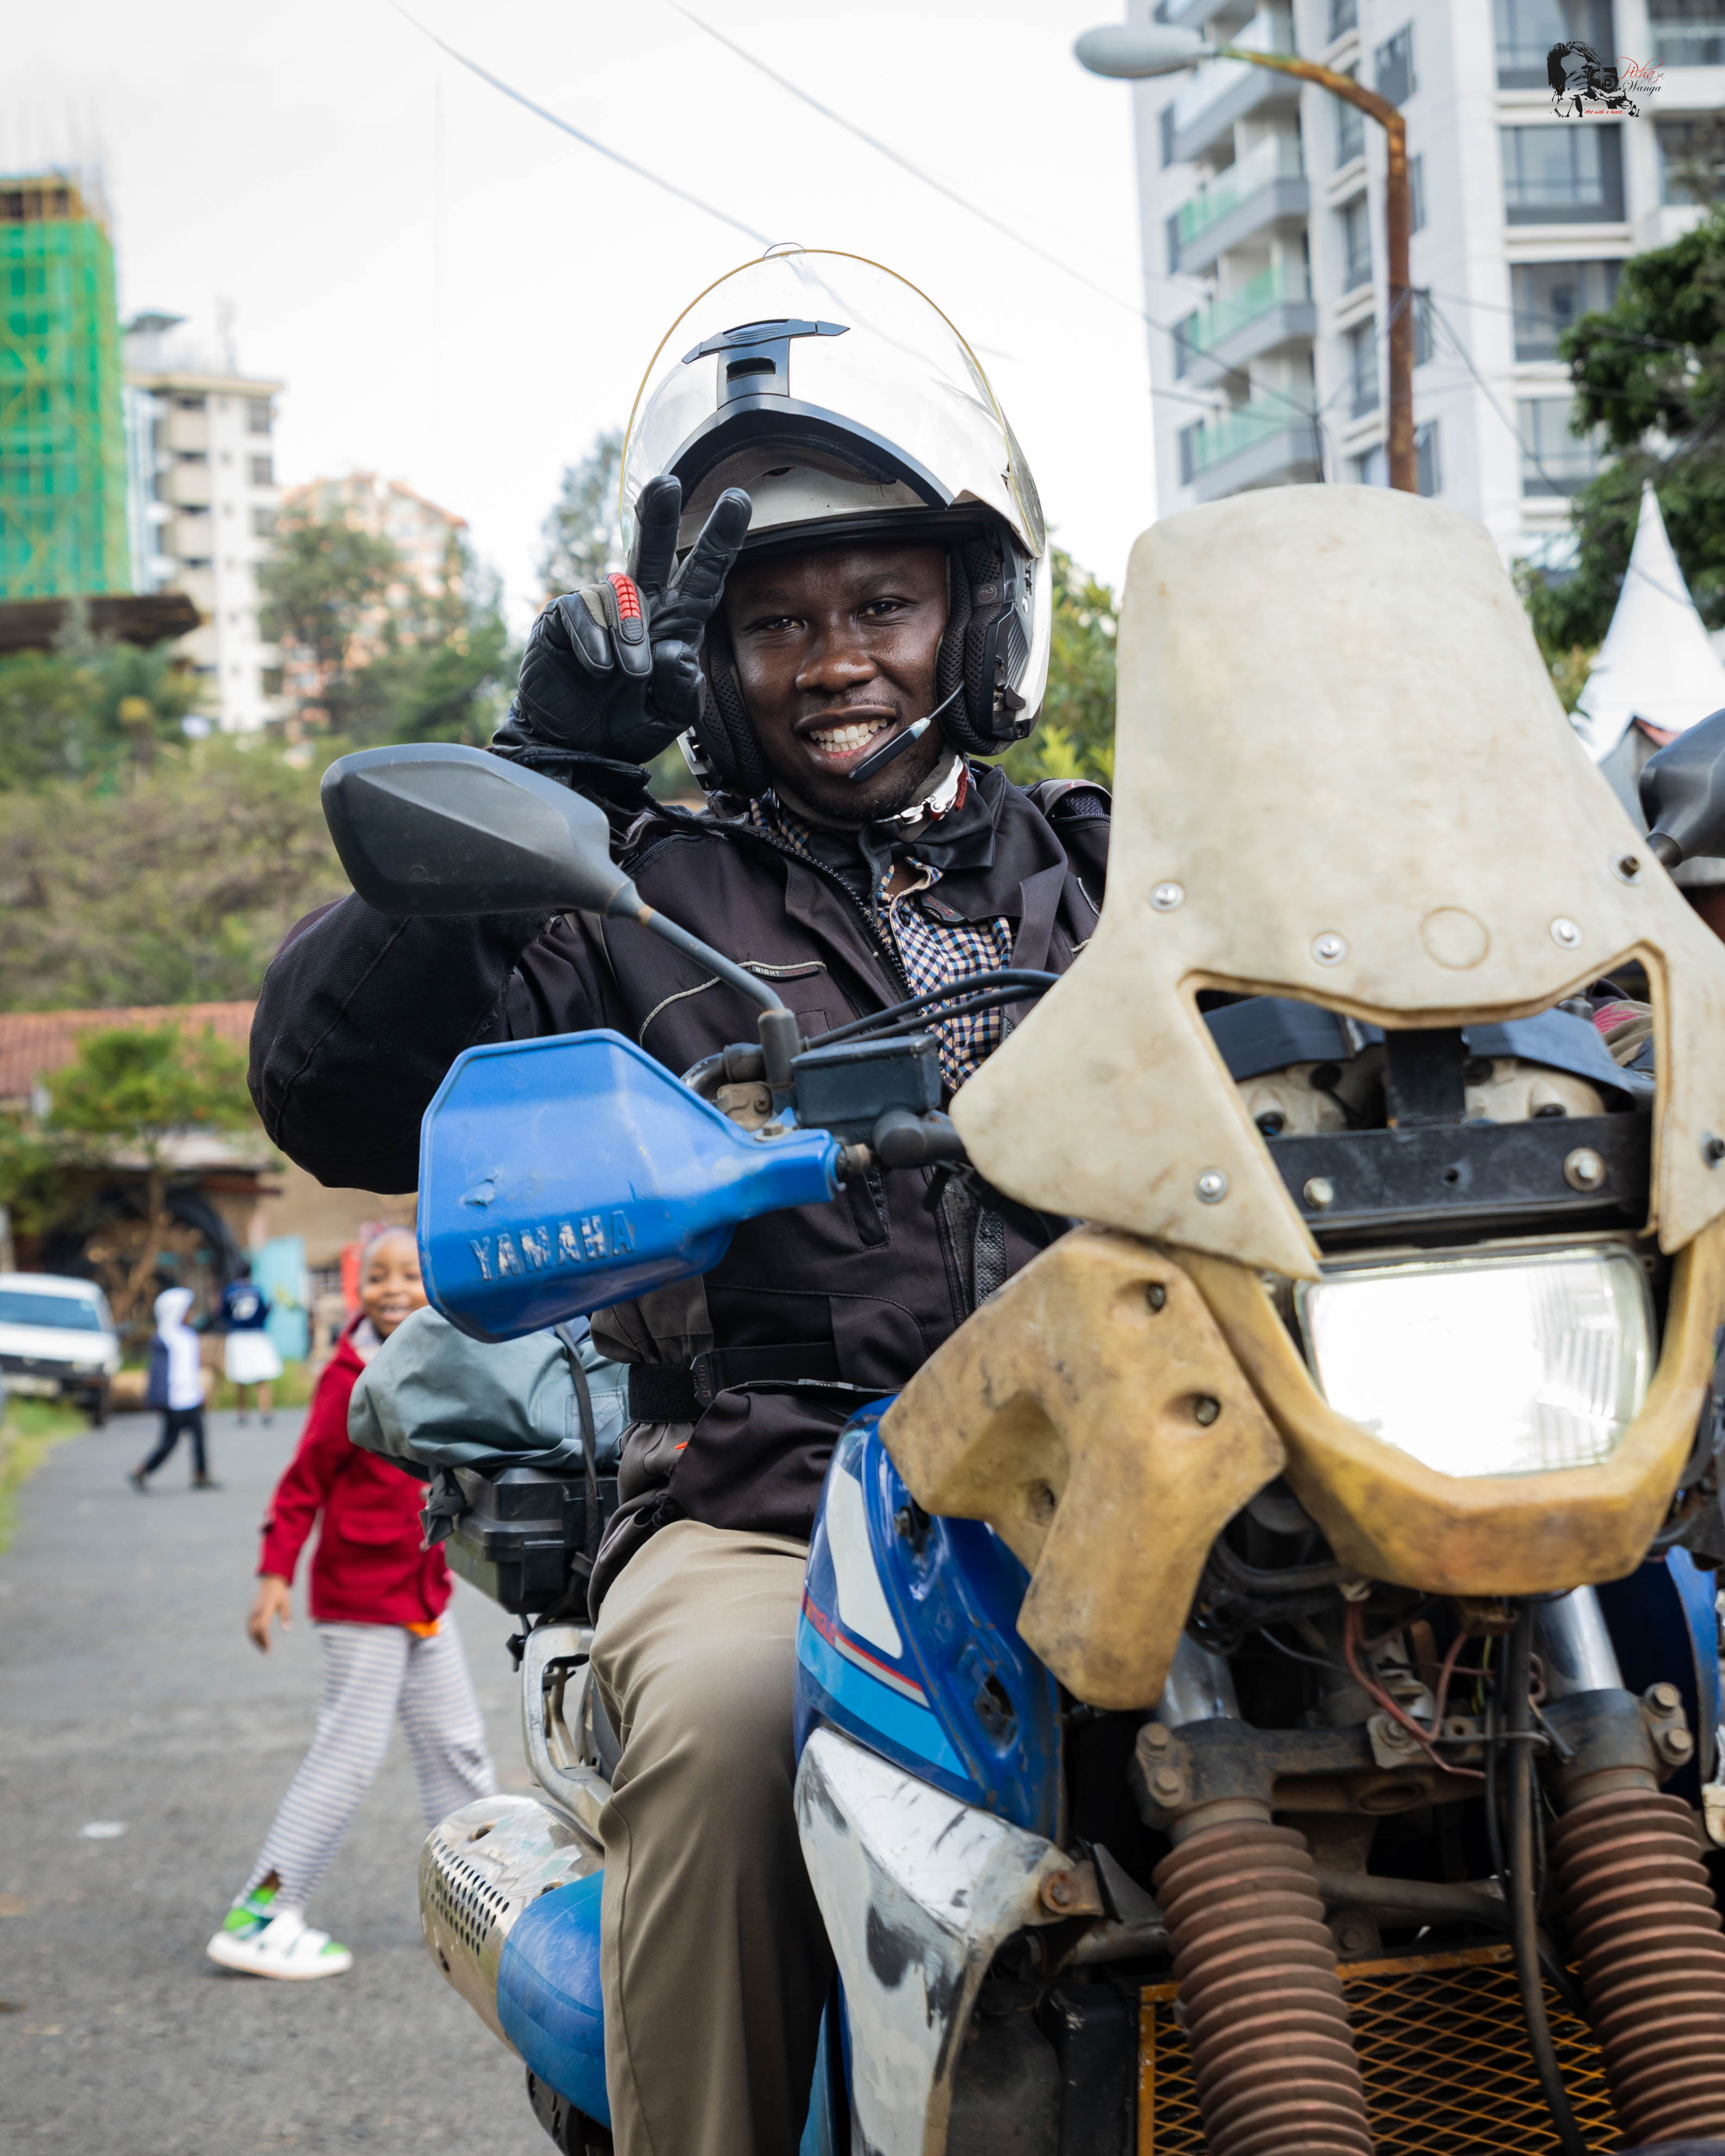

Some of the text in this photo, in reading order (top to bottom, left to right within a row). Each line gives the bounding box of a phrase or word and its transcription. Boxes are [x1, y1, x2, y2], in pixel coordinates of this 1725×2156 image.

[755, 966, 812, 976] NIGHT VISION
[469, 1210, 635, 1281] YAMAHA
